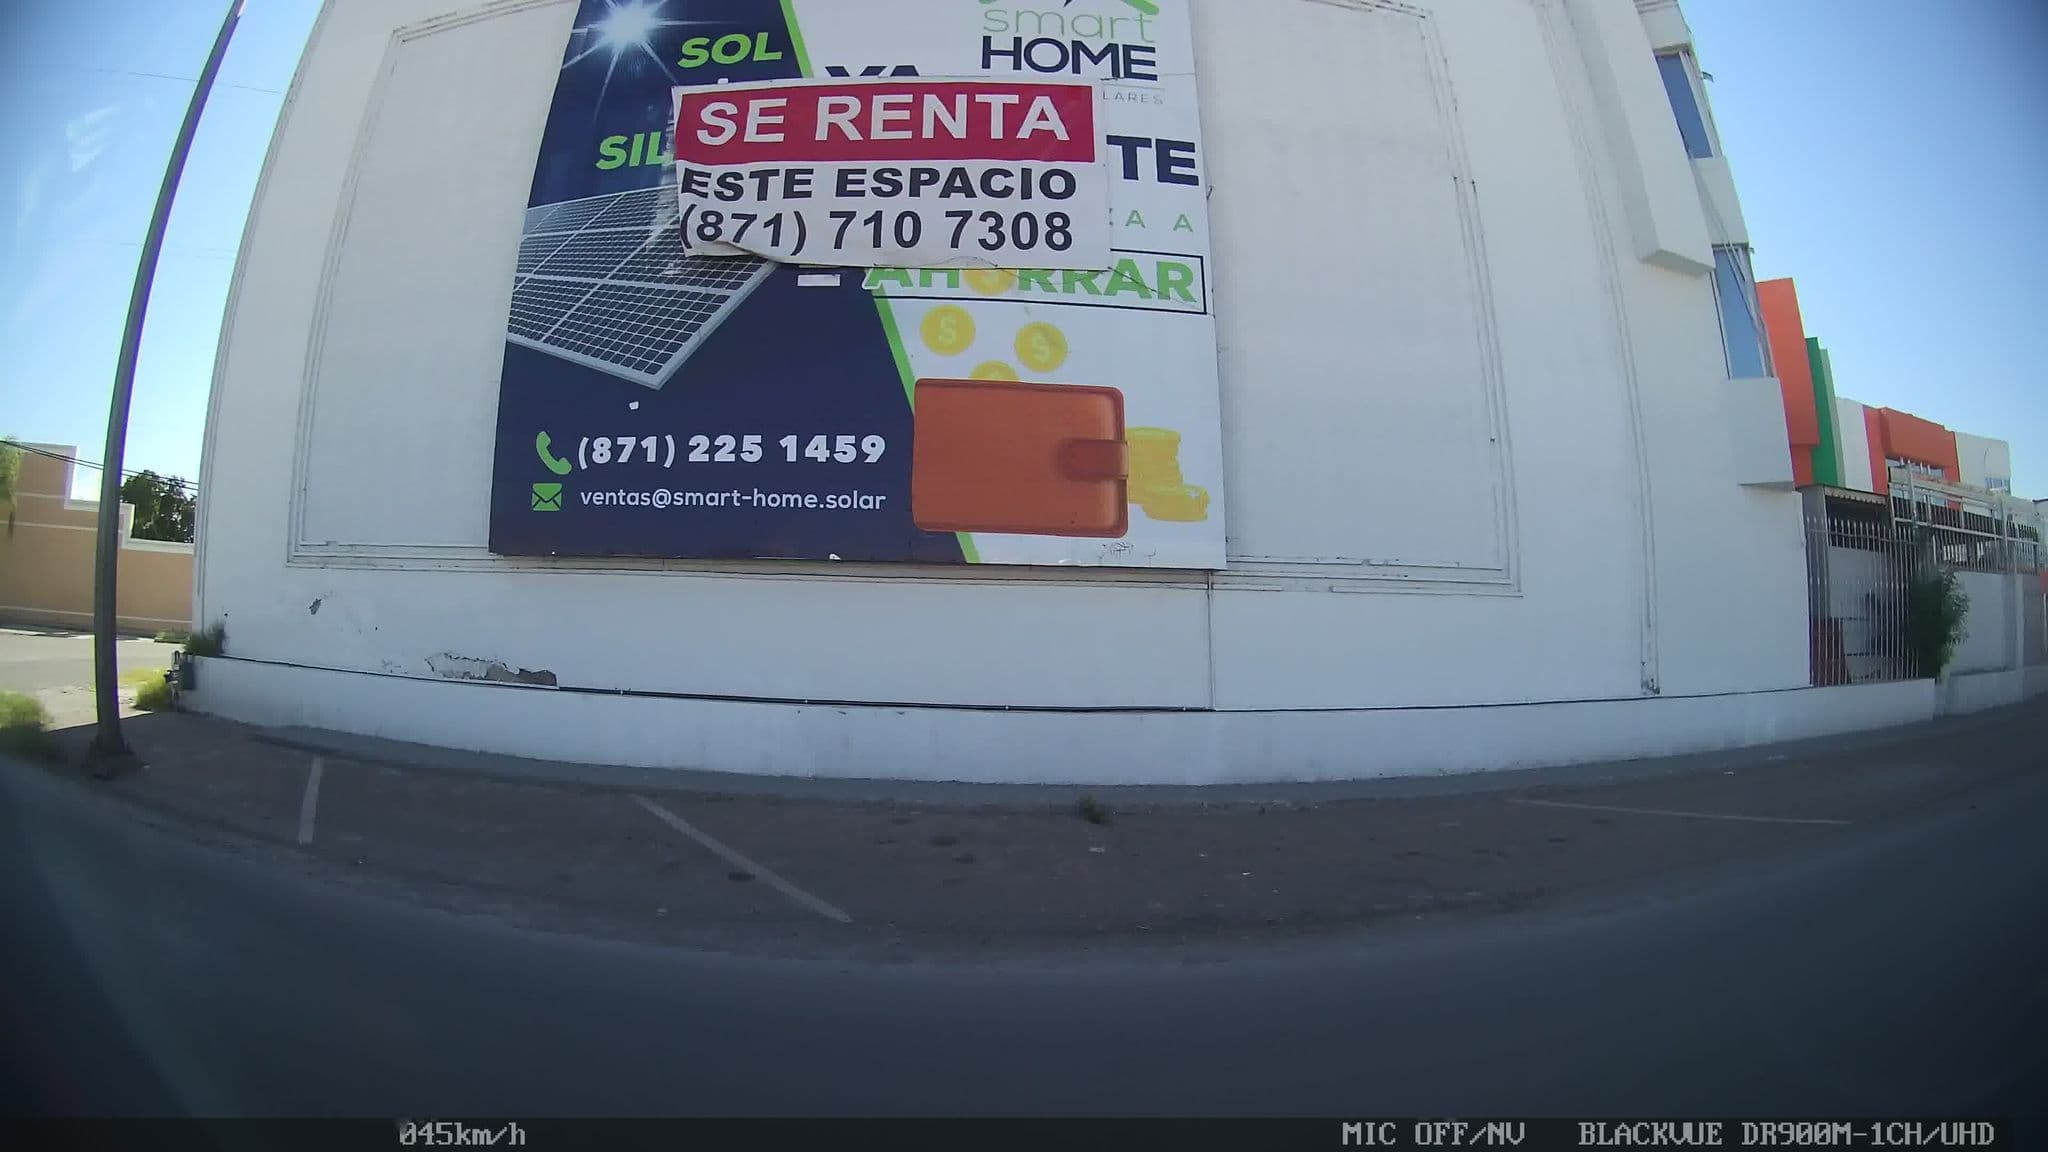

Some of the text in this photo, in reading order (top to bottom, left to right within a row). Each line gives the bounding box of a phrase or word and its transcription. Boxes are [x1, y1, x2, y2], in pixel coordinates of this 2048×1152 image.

[984, 9, 1155, 43] smart
[677, 32, 783, 69] SOL
[981, 35, 1158, 81] HOME
[697, 93, 1071, 146] SE RENTA
[1106, 134, 1199, 187] TE
[681, 167, 1077, 201] ESTE ESPACIO
[680, 204, 1073, 257] (871) 710 7308
[578, 434, 886, 470] (871) 225 1459
[580, 488, 887, 510] ventas@smart-home.solar
